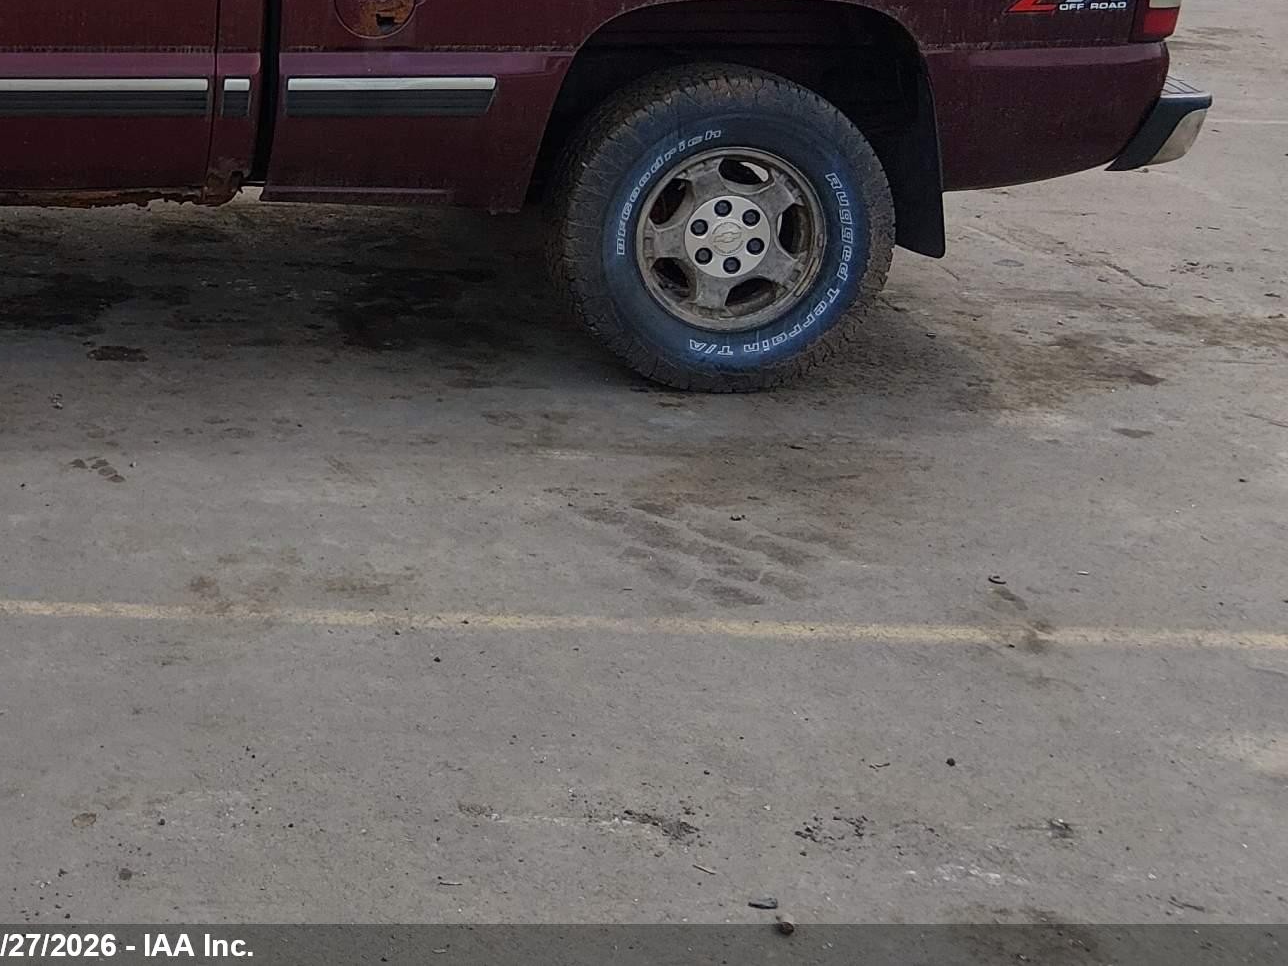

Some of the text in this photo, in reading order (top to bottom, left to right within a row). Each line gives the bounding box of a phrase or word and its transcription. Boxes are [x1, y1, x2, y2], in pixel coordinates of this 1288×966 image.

[1059, 1, 1127, 11] OFF ROAD
[616, 128, 722, 256] BFGoodrich
[689, 172, 855, 356] Rugged Terrain T/A
